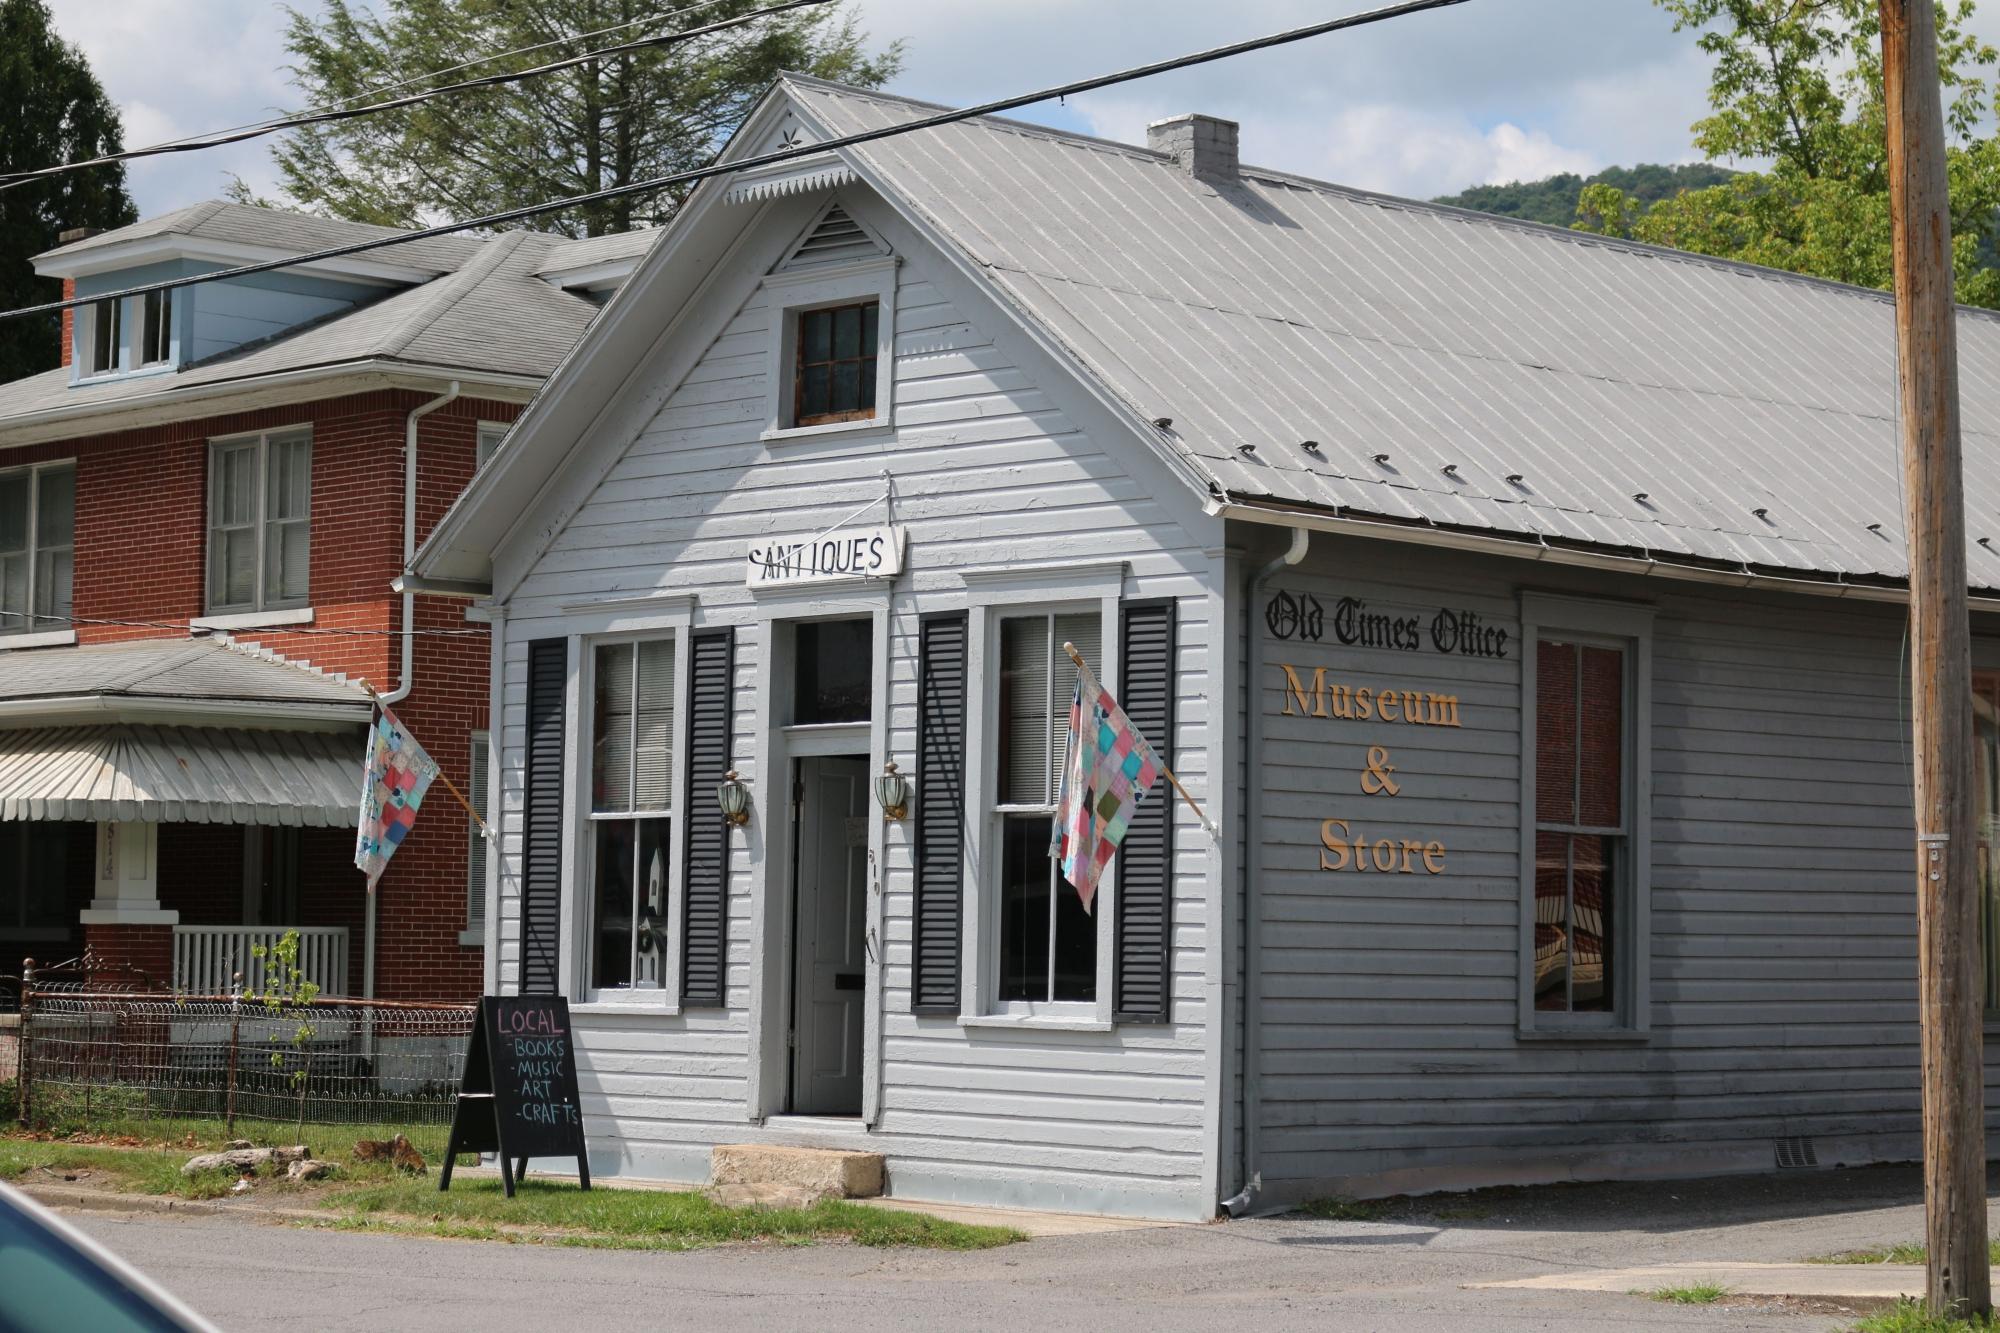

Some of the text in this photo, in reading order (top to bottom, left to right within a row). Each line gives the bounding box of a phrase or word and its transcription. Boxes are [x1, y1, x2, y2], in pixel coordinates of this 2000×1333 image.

[761, 536, 884, 579] ANTIQUES
[1265, 589, 1509, 658] Old Times Office
[1280, 663, 1462, 727] Museum
[1360, 745, 1400, 797] &
[1320, 818, 1447, 874] Store
[497, 1008, 565, 1034] LOCAL
